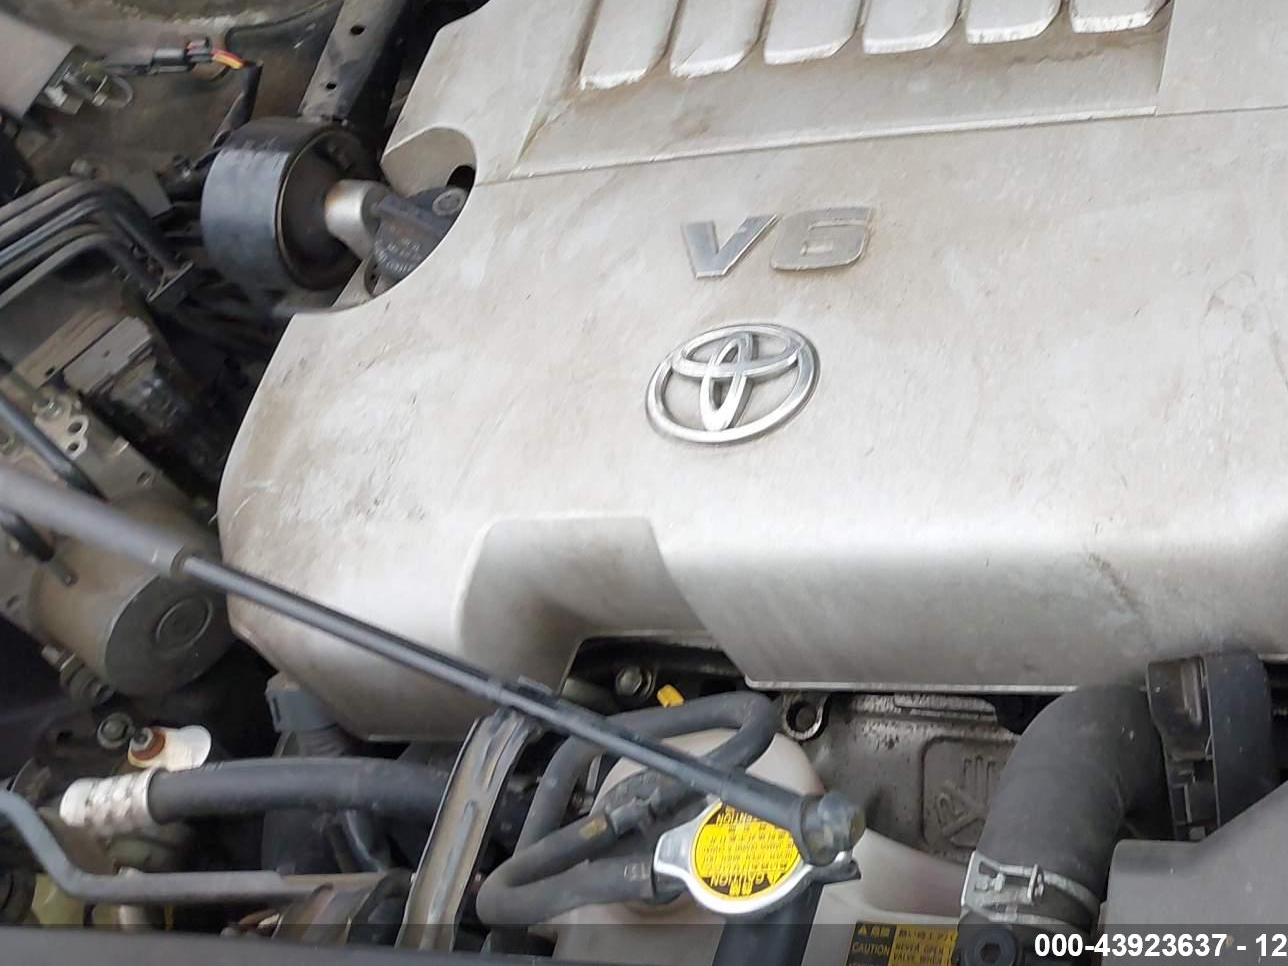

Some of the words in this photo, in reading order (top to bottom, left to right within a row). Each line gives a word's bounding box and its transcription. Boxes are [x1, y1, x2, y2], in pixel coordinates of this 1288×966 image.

[680, 206, 872, 279] V6
[710, 874, 764, 885] CAUTION
[852, 941, 890, 955] CAUTION
